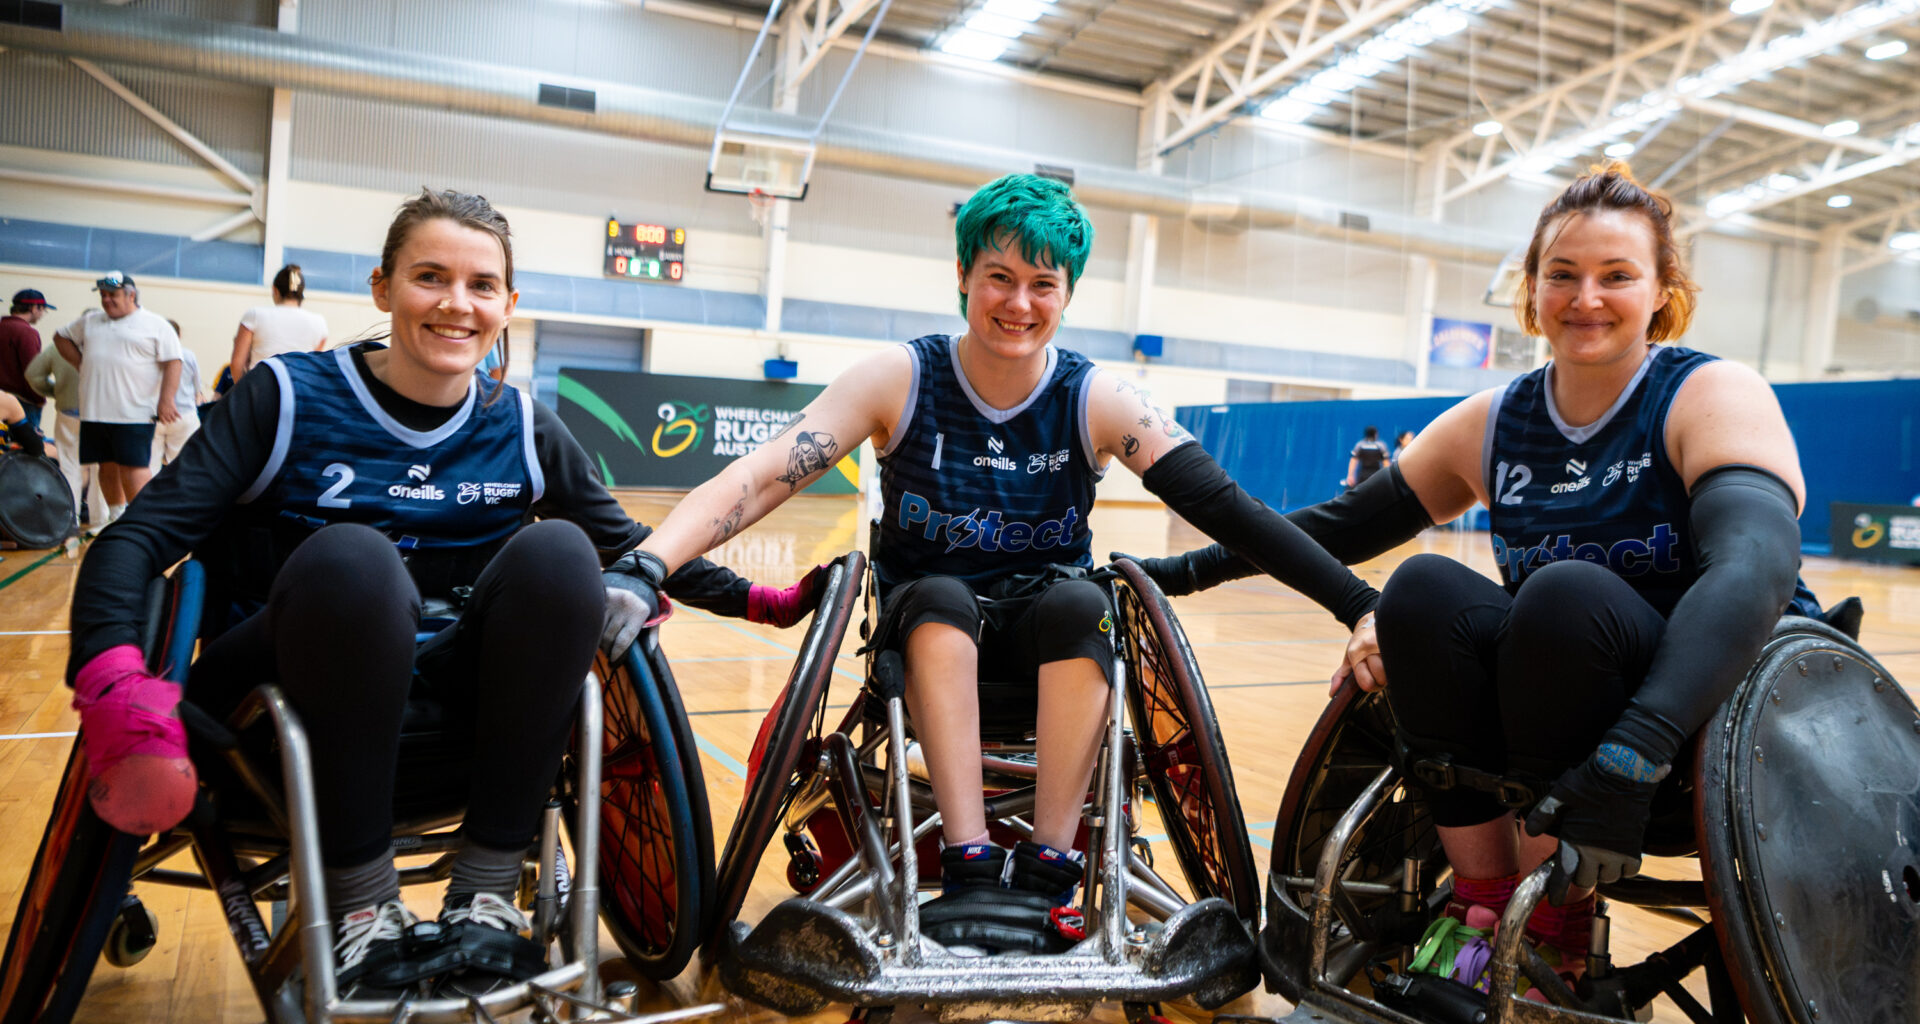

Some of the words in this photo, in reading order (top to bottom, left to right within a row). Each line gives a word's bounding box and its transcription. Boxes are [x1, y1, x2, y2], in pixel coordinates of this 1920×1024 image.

[714, 406, 800, 423] WHEELCHAI
[714, 419, 785, 443] RUGB
[931, 432, 945, 471] 1
[316, 462, 356, 509] 2
[484, 487, 521, 498] RUGBY
[1495, 461, 1532, 505] 12
[485, 496, 501, 505] VIC
[899, 491, 1078, 554] Protect
[967, 846, 982, 855] NIKE
[1044, 848, 1059, 859] NIKE
